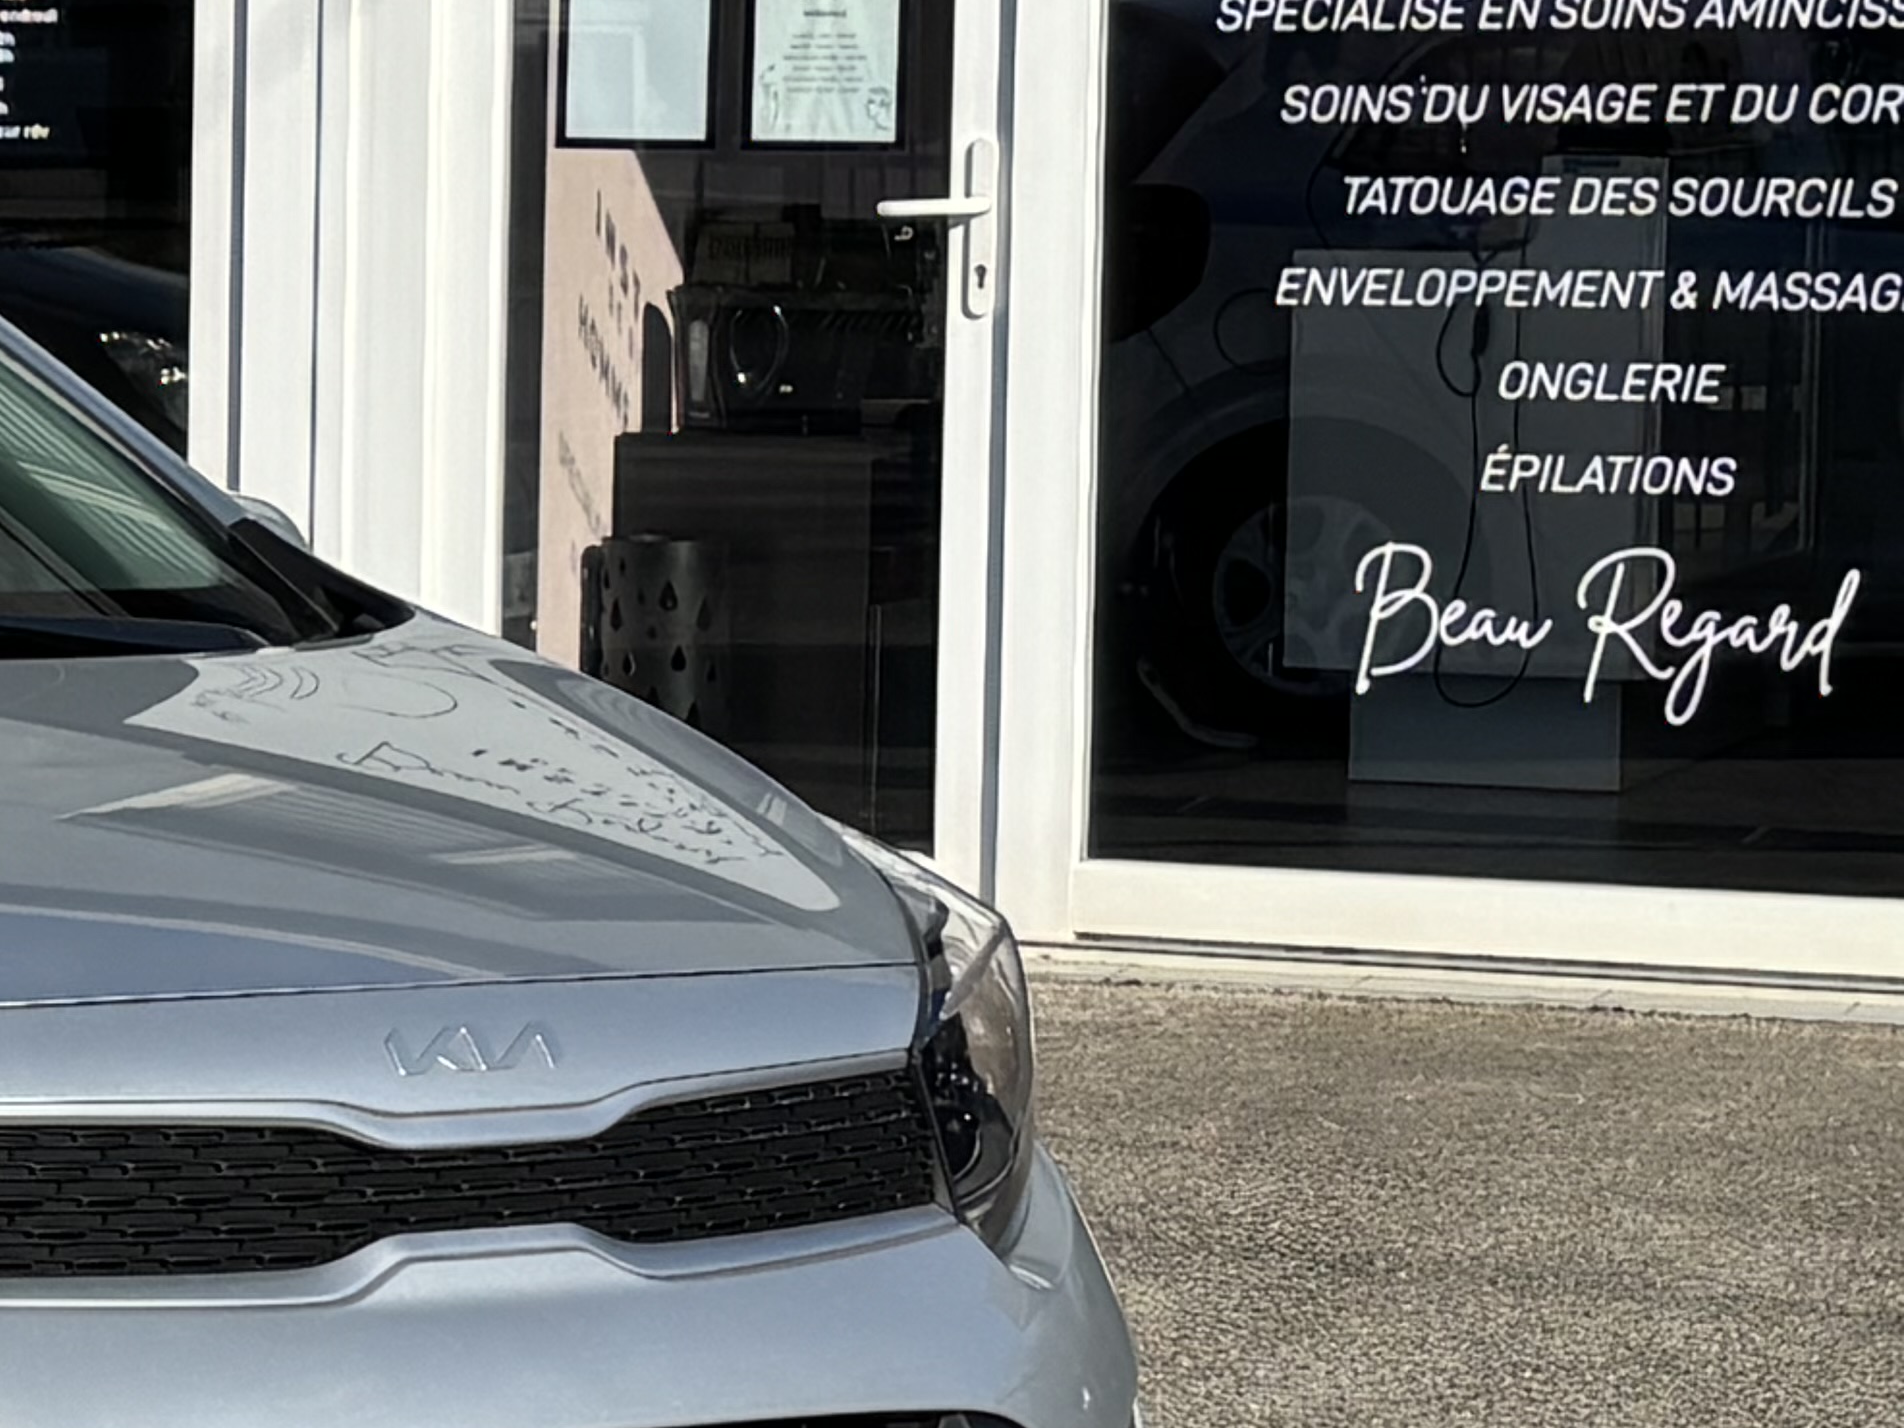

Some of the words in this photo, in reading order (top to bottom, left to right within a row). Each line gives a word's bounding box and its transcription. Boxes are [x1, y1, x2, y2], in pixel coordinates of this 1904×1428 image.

[1281, 85, 1414, 123] SOINS
[1422, 84, 1489, 124] DU
[1503, 84, 1657, 122] VISAGE
[1666, 84, 1725, 122] ET
[1731, 84, 1798, 123] DU
[1344, 177, 1561, 215] TATOUAGE
[1569, 178, 1659, 215] DES
[1669, 178, 1898, 218] SOURCILS
[1276, 268, 1664, 308] ENVELOPPEMENT
[1670, 271, 1697, 309] &
[1713, 271, 1904, 312] MASSAG
[1499, 361, 1725, 402] ONGLERIE
[1481, 444, 1736, 495] ÉPILATIONS
[1356, 542, 1552, 694] Beau
[1577, 548, 1860, 725] Regard
